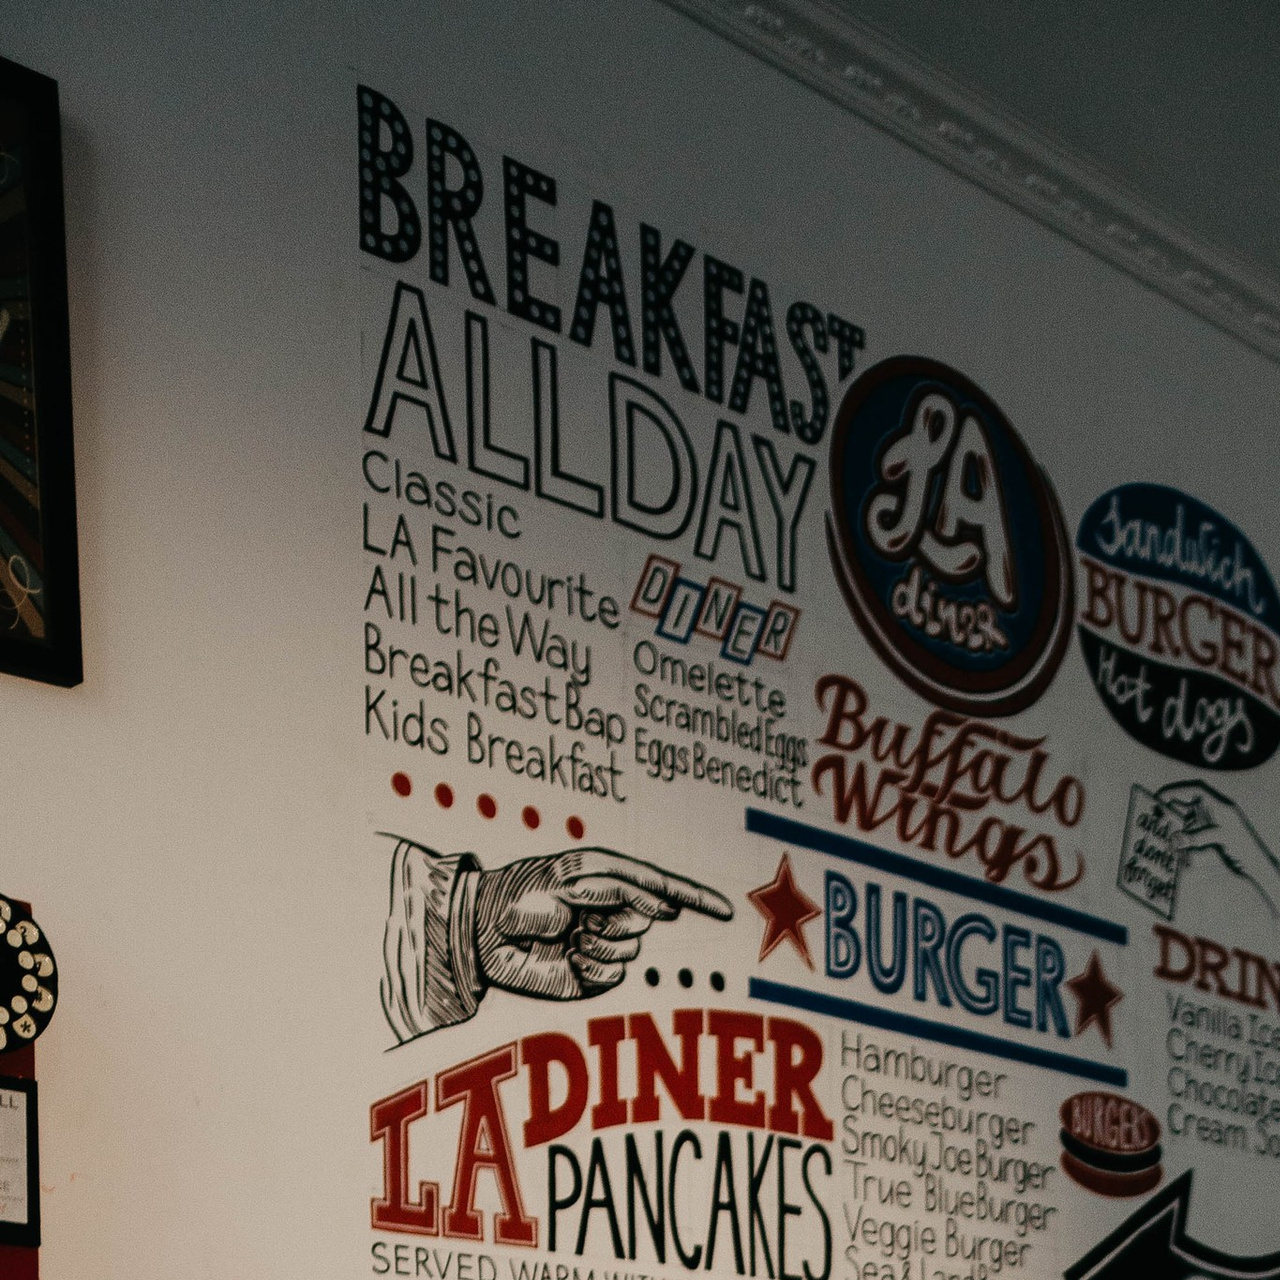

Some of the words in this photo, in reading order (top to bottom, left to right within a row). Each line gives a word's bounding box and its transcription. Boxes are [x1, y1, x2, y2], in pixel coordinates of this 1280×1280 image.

[357, 83, 865, 445] BREAKFAST
[362, 450, 521, 539] Classic
[863, 381, 1019, 614] LA
[363, 502, 417, 566] LA
[432, 524, 621, 631] Favourite
[363, 565, 417, 625] All
[1095, 494, 1265, 614] Sandwich
[637, 558, 797, 661] DINER
[889, 562, 1010, 654] diner
[364, 622, 560, 725] Breakfast
[633, 641, 786, 719] Omelette
[634, 683, 763, 752] Scrambled
[1099, 644, 1157, 729] Hot
[1161, 676, 1256, 763] dogs
[365, 686, 450, 756] Kids
[467, 711, 627, 804] Breakfast
[634, 728, 689, 782] Eggs
[692, 741, 803, 808] Benedict
[814, 674, 1084, 827] Buffalo
[810, 752, 1085, 891] Wings
[824, 869, 1071, 1040] BURGER
[521, 1008, 833, 1148] DINER
[841, 1028, 1008, 1101] Hamburger
[842, 1073, 1036, 1150] Cheeseburger
[369, 1041, 539, 1249] LA
[842, 1114, 926, 1179] Smoky
[1166, 1102, 1247, 1149] Cream
[843, 1159, 912, 1208] True
[842, 1203, 936, 1261] Veggie
[946, 1217, 1032, 1273] Burger
